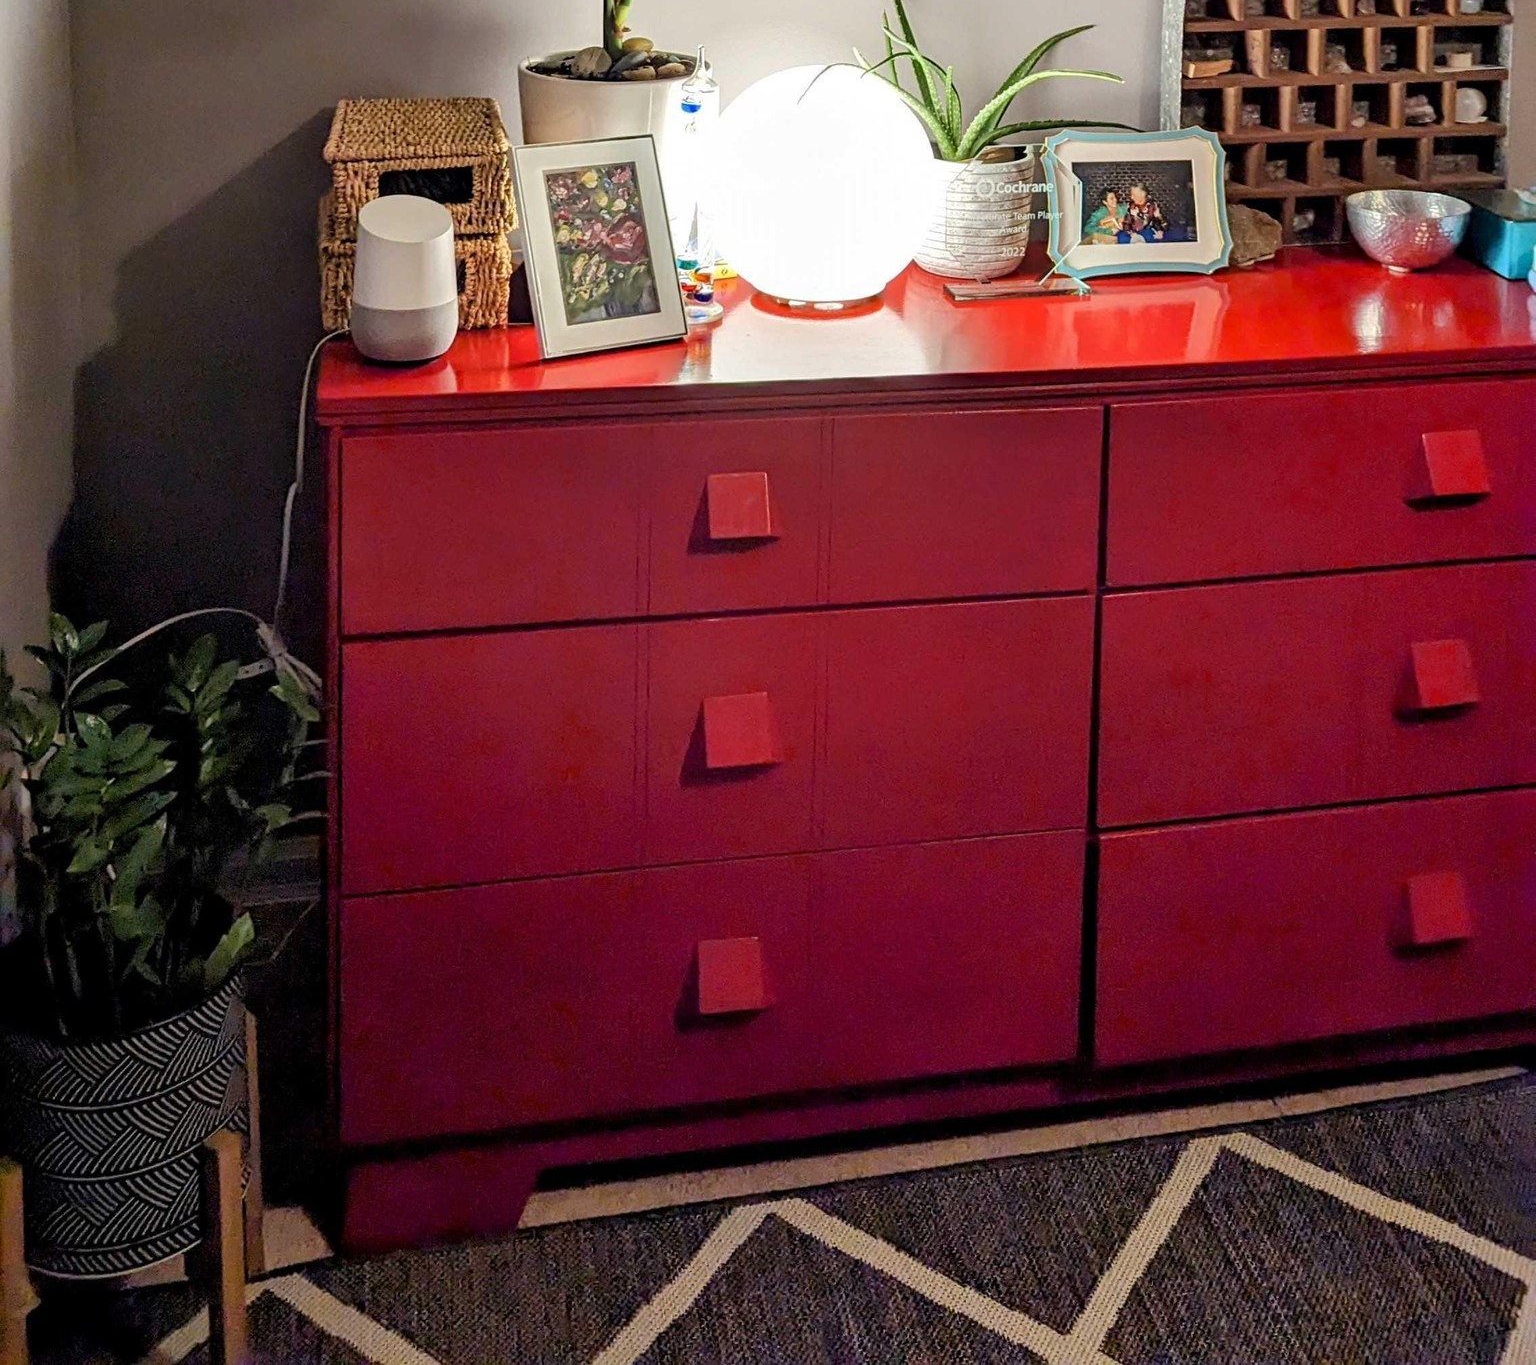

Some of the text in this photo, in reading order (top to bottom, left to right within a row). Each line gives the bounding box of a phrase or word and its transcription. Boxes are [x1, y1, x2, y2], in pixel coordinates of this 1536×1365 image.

[996, 180, 1054, 194] Cochrane
[1013, 211, 1036, 221] Team
[1037, 210, 1064, 222] Player
[1000, 225, 1027, 234] Award
[1000, 247, 1026, 257] 2022
